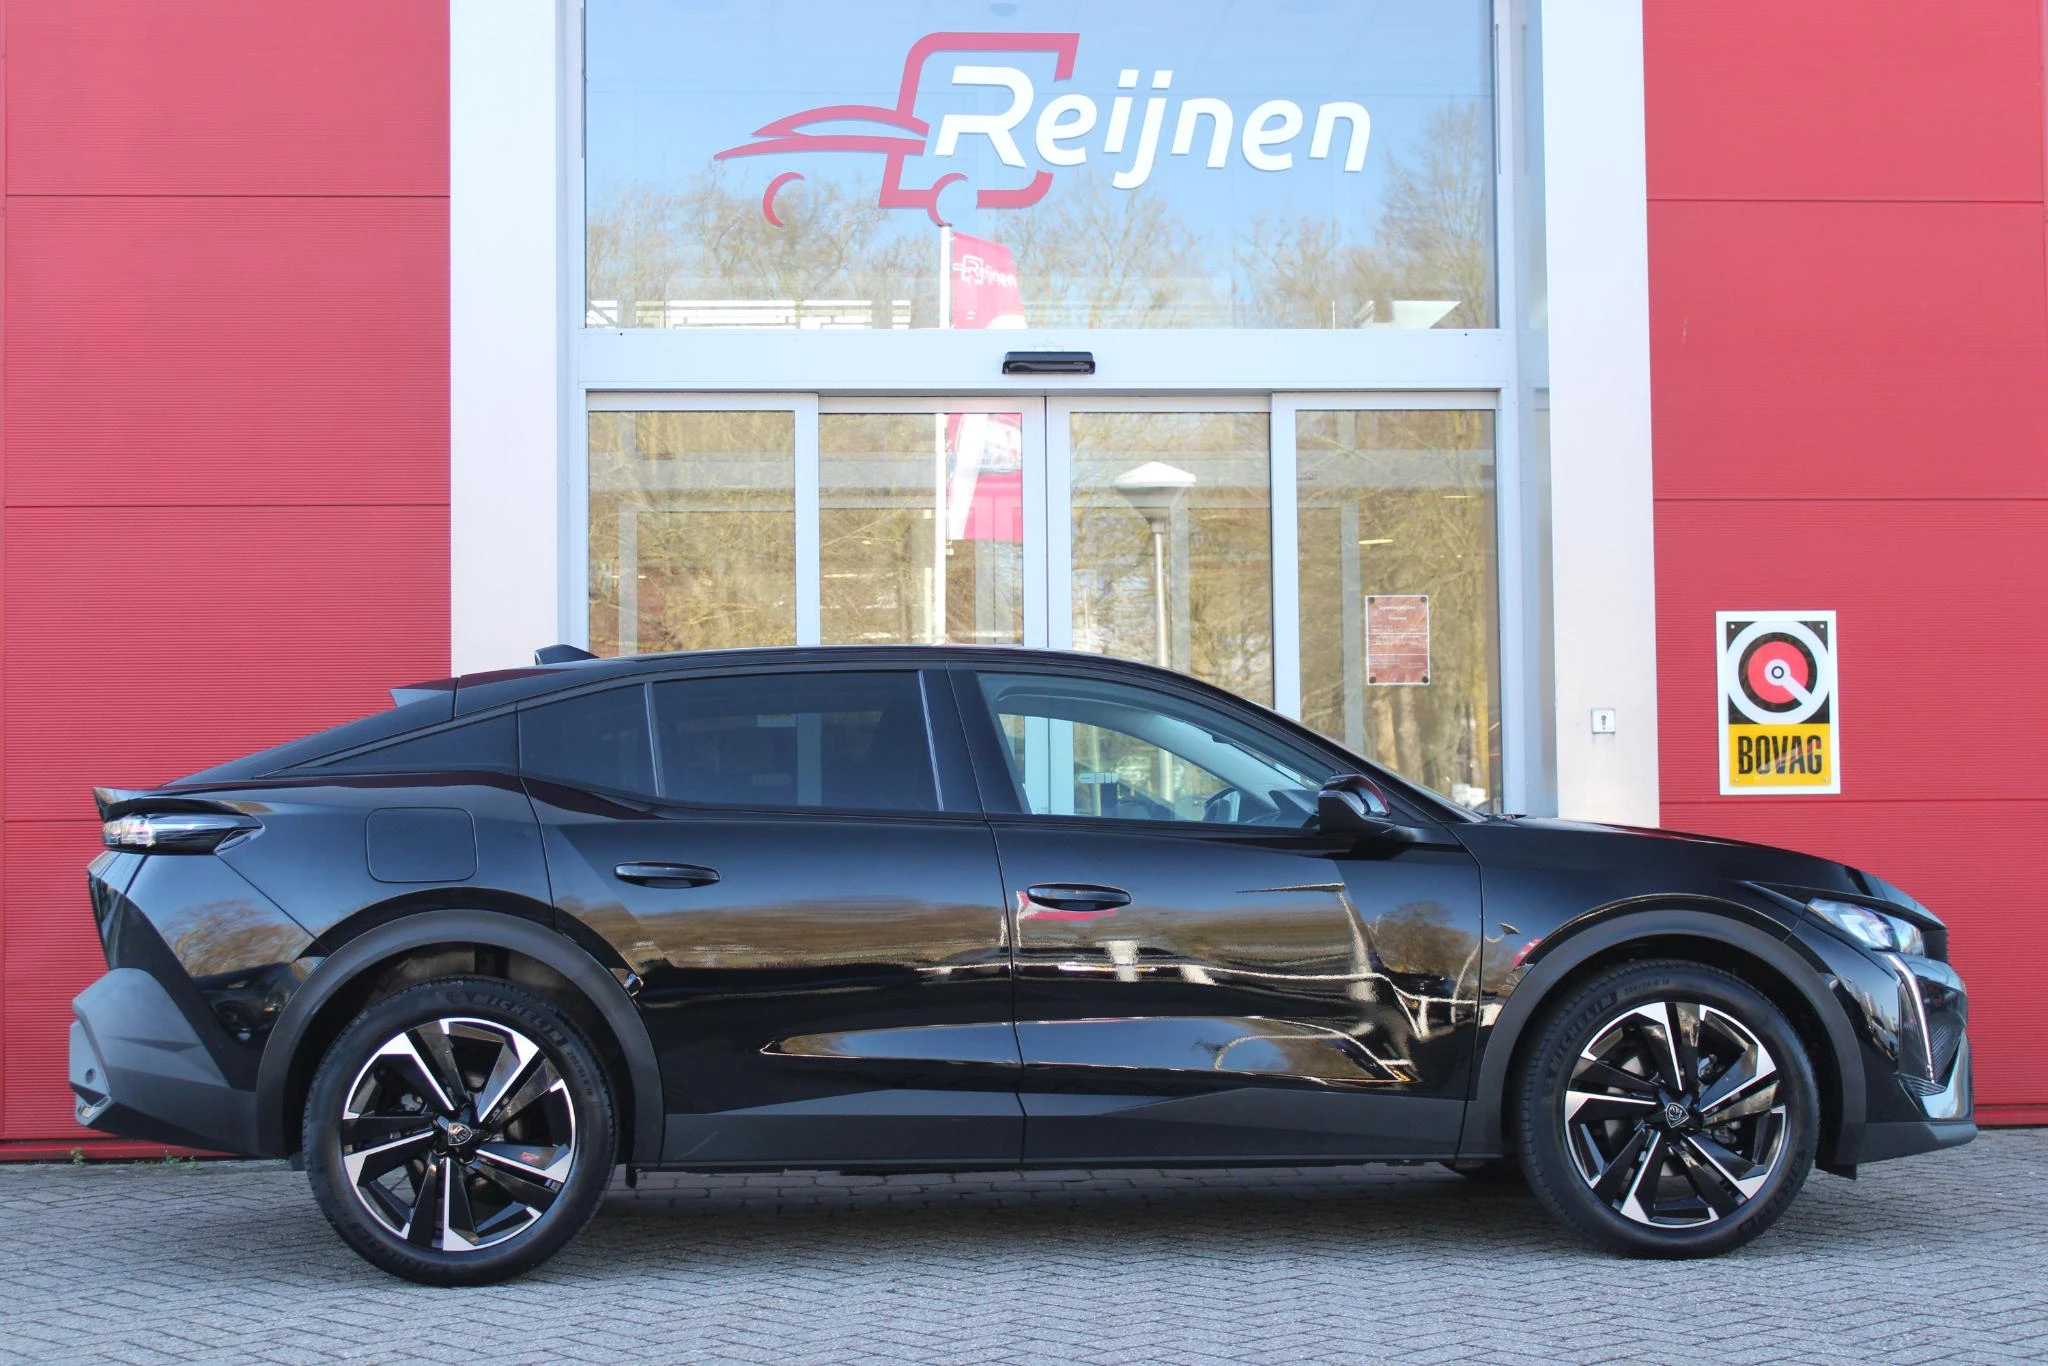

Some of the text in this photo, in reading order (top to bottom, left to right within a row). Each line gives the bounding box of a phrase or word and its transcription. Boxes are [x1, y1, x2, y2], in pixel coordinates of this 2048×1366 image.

[933, 64, 1372, 190] Reijnen
[1737, 734, 1823, 775] BOVAG
[472, 992, 565, 1042] MICHELIN
